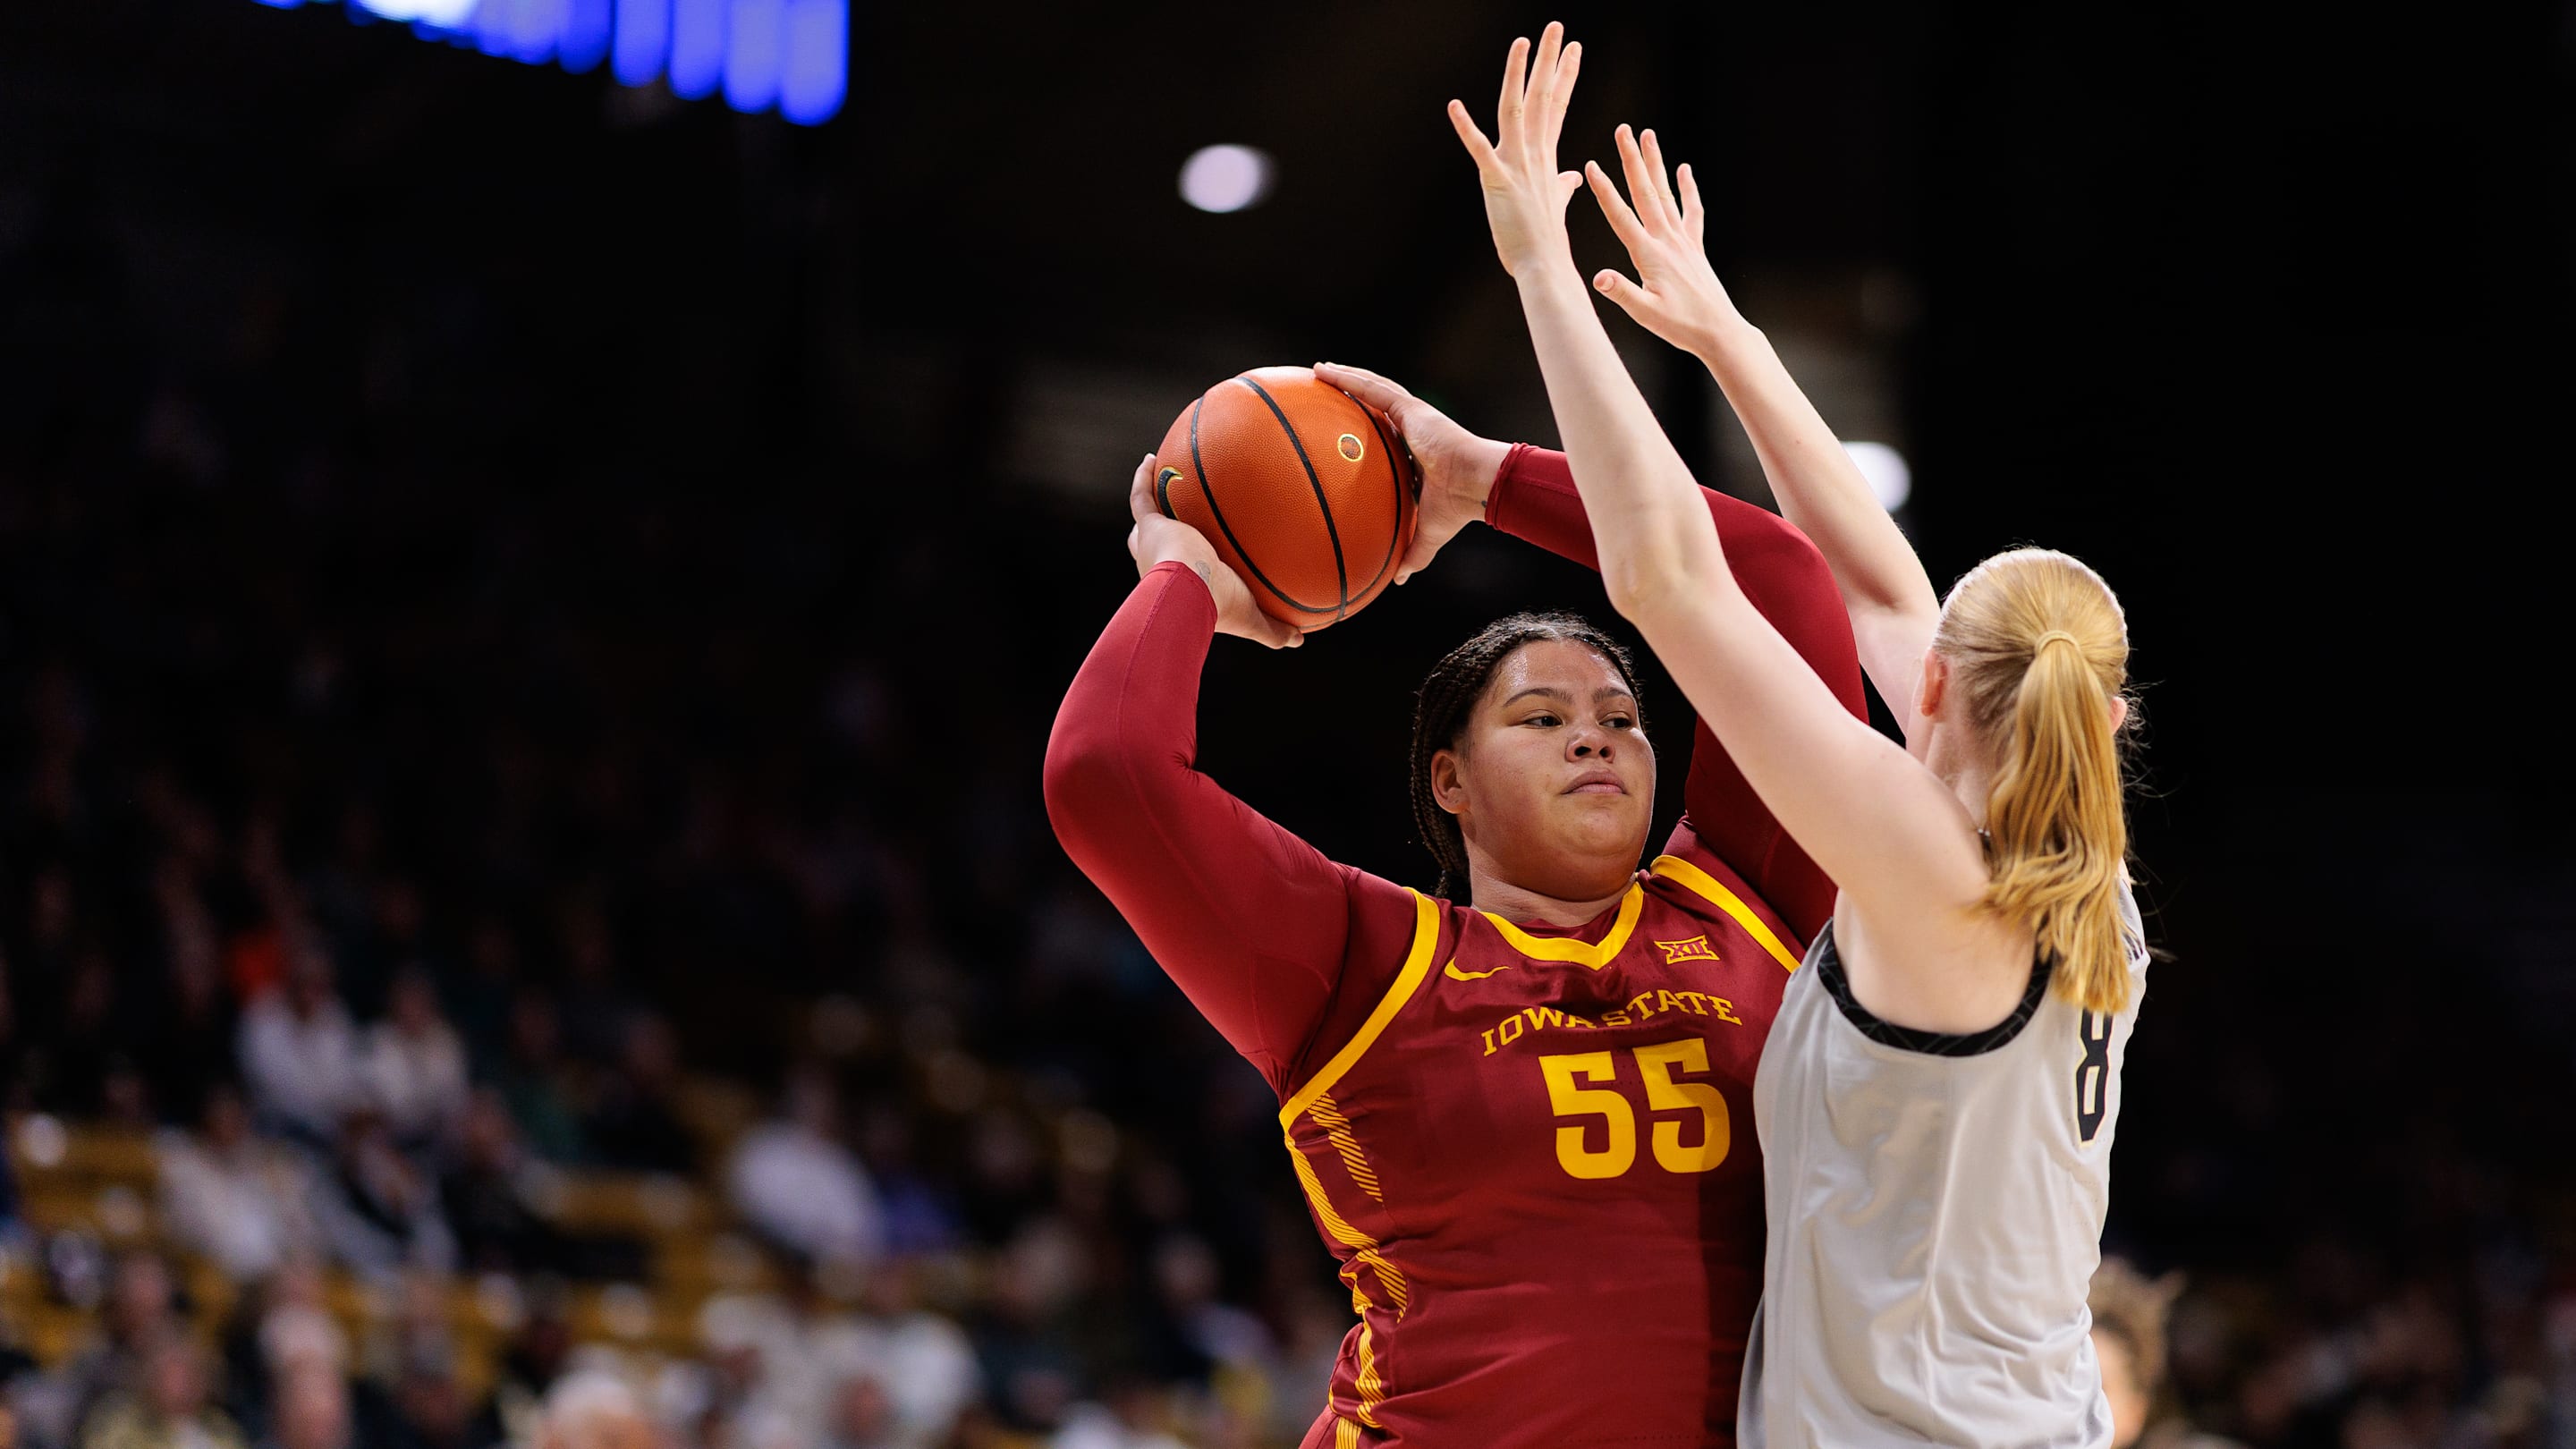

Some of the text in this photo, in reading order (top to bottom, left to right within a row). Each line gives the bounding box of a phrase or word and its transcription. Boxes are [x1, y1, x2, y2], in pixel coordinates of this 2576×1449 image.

[1480, 989, 1743, 1056] IOWA STATE
[2075, 1007, 2114, 1143] 8
[1538, 1038, 1732, 1180] 55
